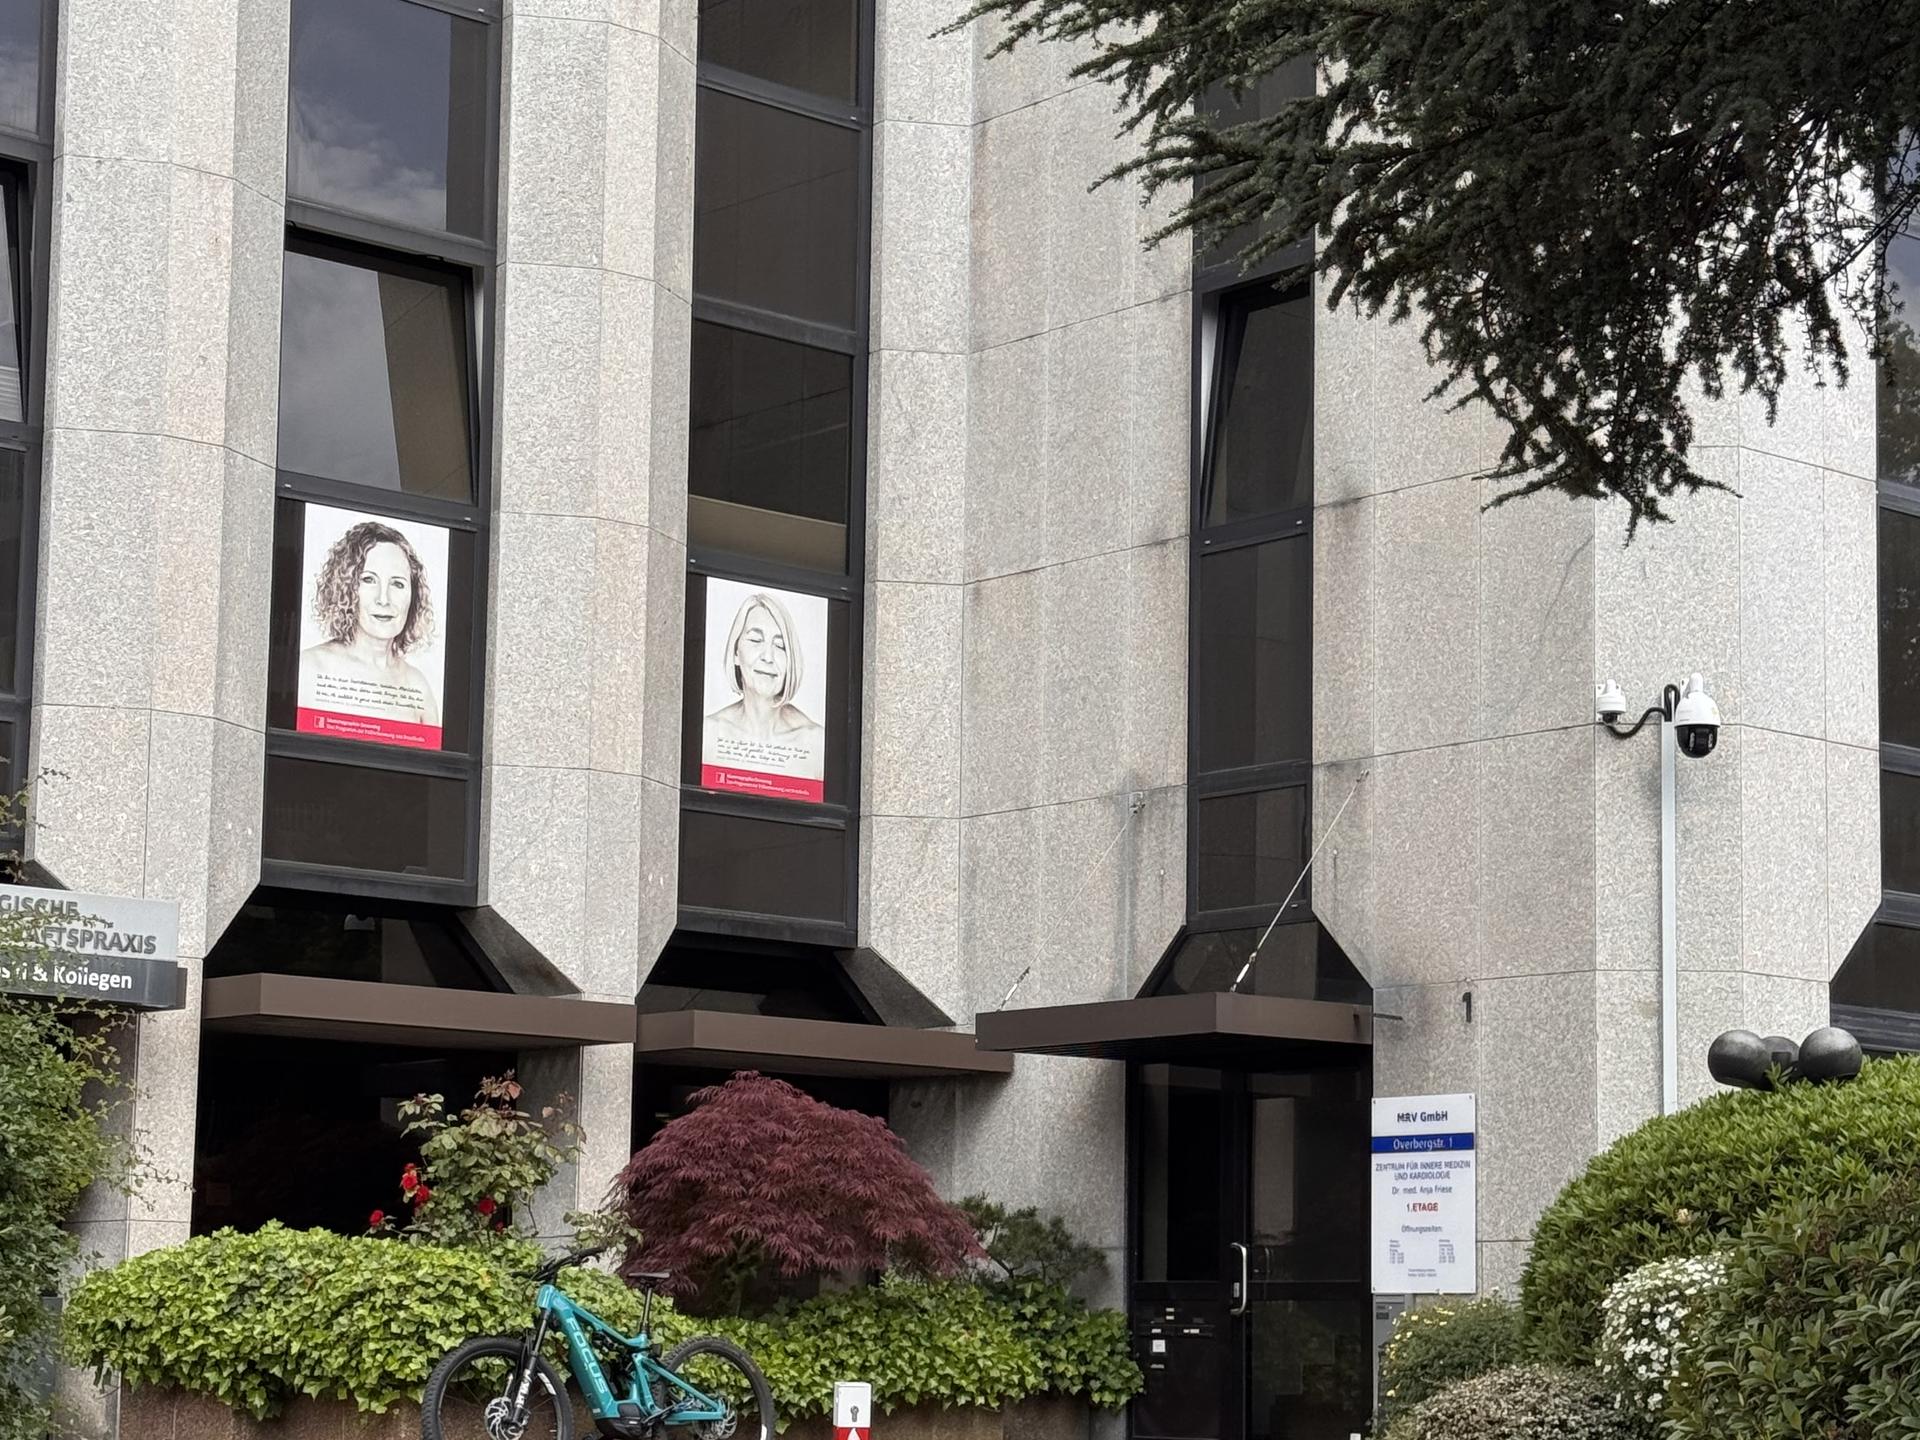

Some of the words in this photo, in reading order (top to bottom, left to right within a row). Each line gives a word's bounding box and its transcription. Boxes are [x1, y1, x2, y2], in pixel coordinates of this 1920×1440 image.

[1462, 991, 1472, 1024] 1
[1397, 1112, 1418, 1123] MRV
[1420, 1111, 1448, 1122] GmbH
[1393, 1138, 1445, 1152] Overbergstr.
[1375, 1163, 1405, 1172] ZENTRUM
[1406, 1161, 1419, 1171] FÜR
[1420, 1161, 1442, 1170] INNERE
[1444, 1160, 1471, 1169] MEDIZIN
[1394, 1172, 1408, 1181] UND
[1409, 1170, 1451, 1180] KARDIOLOGIE
[566, 1317, 608, 1395] FOCUS
